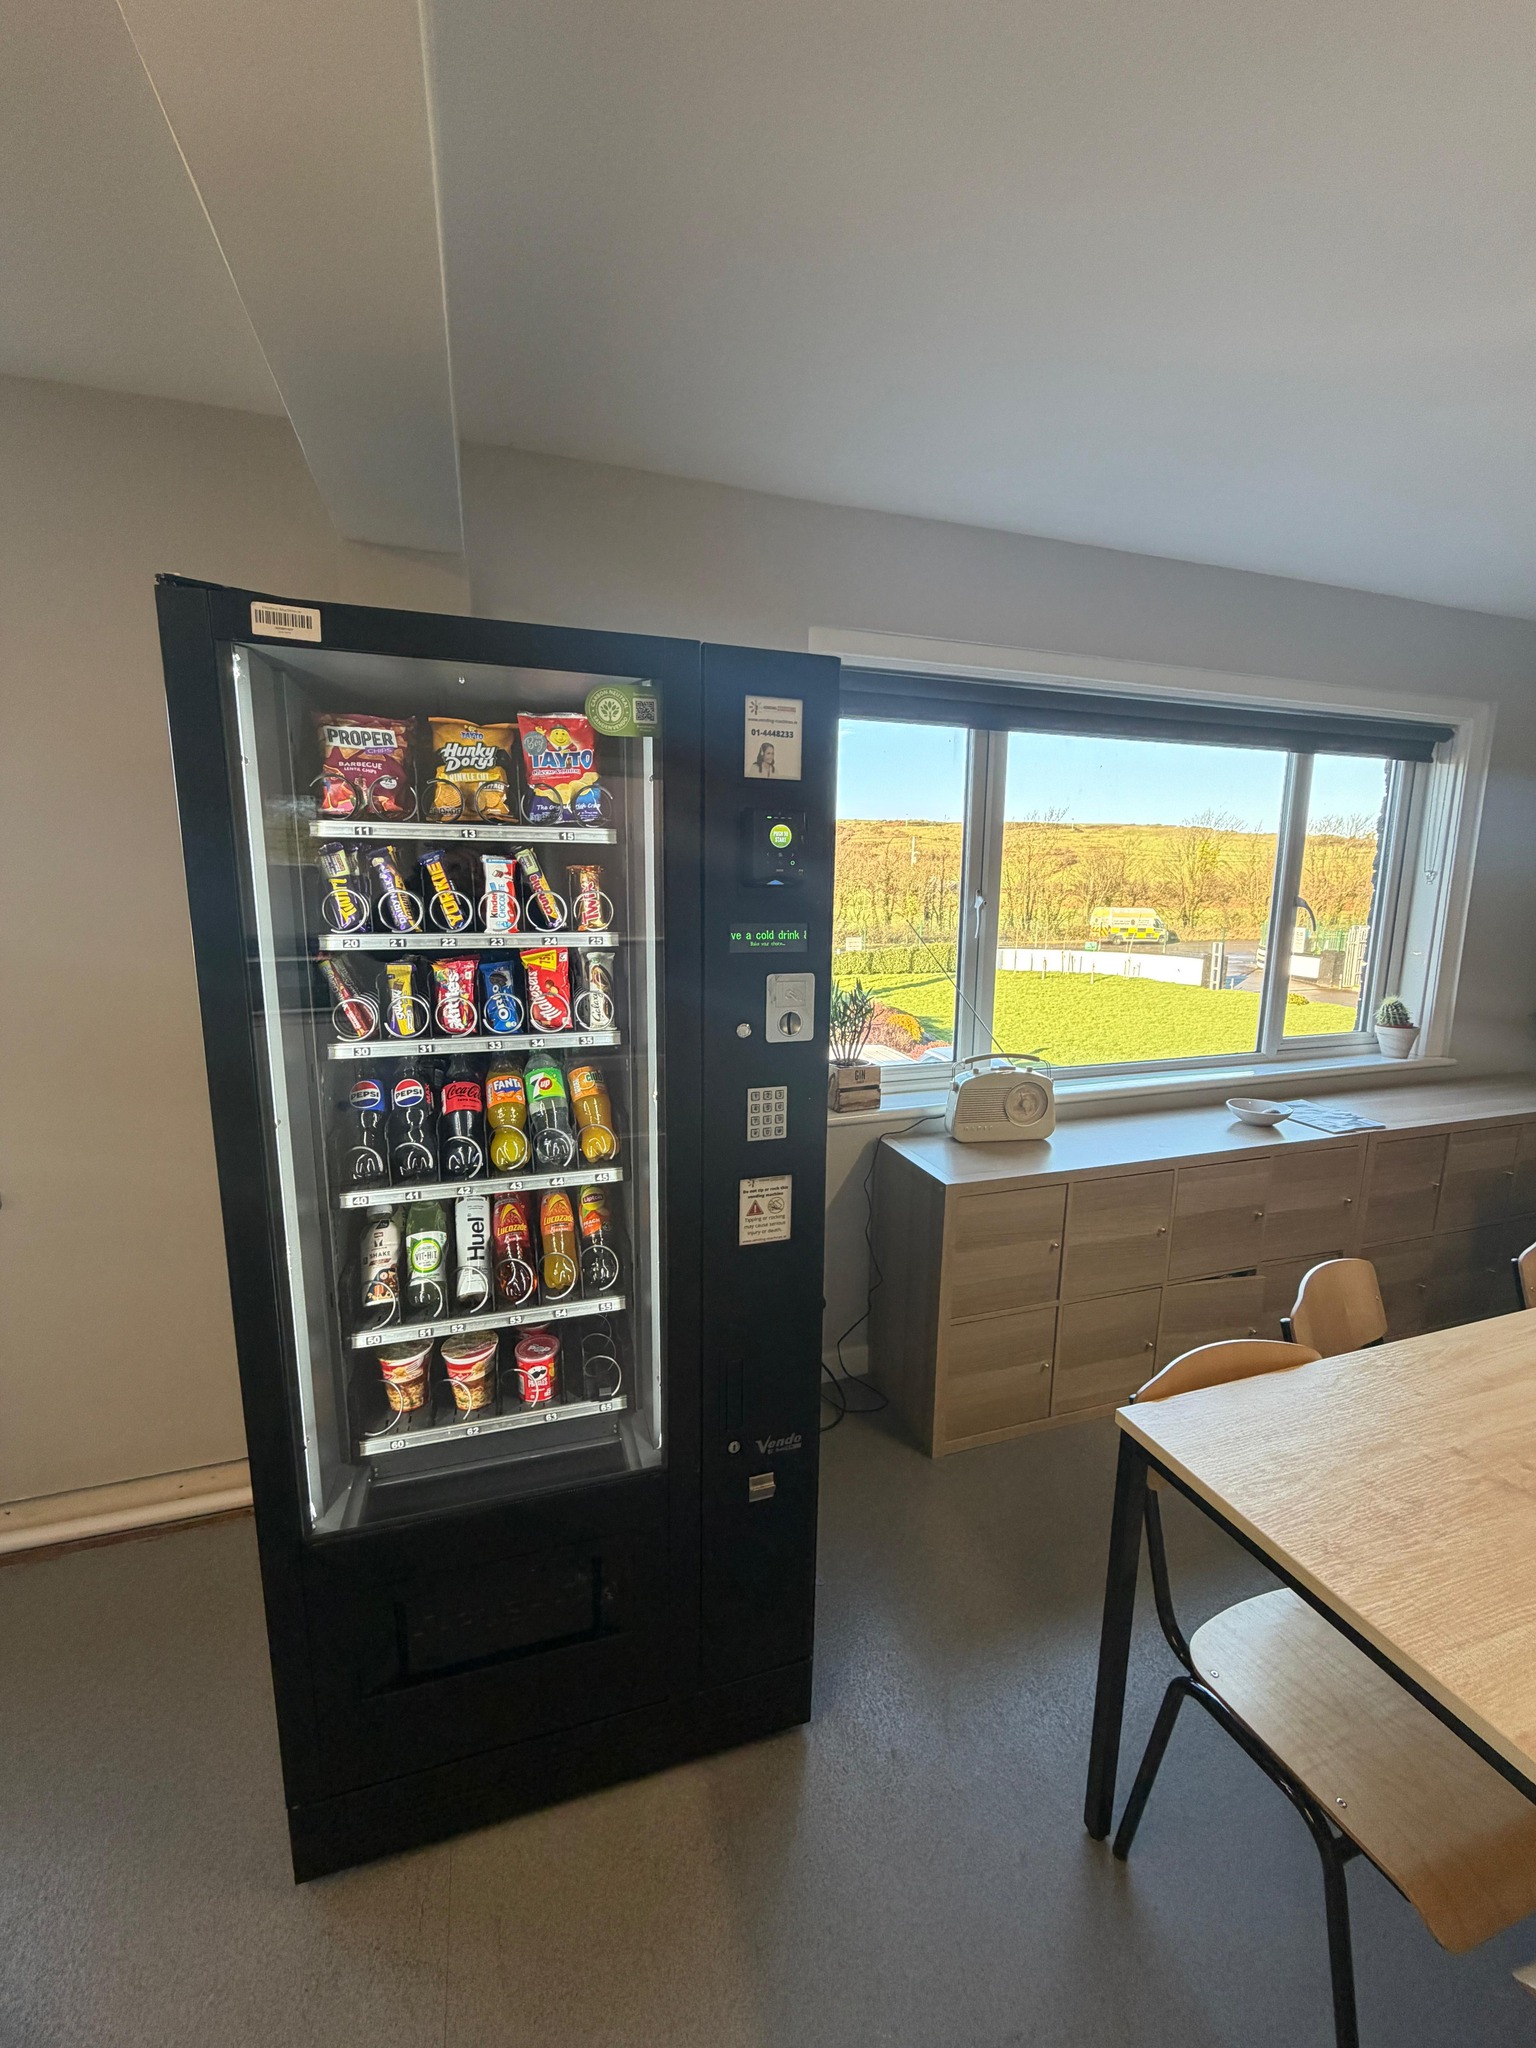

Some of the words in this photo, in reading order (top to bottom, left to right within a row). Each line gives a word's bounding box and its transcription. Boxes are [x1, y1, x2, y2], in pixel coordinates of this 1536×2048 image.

[591, 689, 608, 707] CARBON
[609, 689, 629, 708] NEUTRAL
[326, 728, 394, 747] PROPER
[751, 728, 794, 739] 01-4448233
[367, 747, 393, 755] CHIPS
[441, 742, 497, 760] Hunky
[528, 749, 593, 770] TAYTO
[338, 761, 383, 770] BARBECUE
[445, 756, 496, 773] Dorys
[356, 827, 371, 836] 11
[462, 830, 476, 838] 13
[427, 861, 464, 927] YORKIE
[730, 932, 742, 940] ve
[745, 932, 752, 940] a
[755, 930, 774, 940] cold
[778, 930, 800, 940] drink
[343, 939, 358, 947] 20
[390, 939, 404, 947] 21
[442, 938, 455, 946] 22
[491, 938, 504, 946] 23
[544, 937, 557, 945] 24
[591, 991, 604, 1022] Galaxy
[355, 1048, 369, 1056] 30
[351, 1091, 379, 1100] PEPSI
[395, 1088, 422, 1098] PEPSI
[596, 1173, 609, 1181] 45
[510, 1182, 522, 1190] 43
[406, 1191, 419, 1199] 41
[458, 1187, 471, 1195] 42
[353, 1197, 367, 1205] 40
[583, 1195, 602, 1203] Lipton
[497, 1223, 527, 1236] Lucozade
[467, 1217, 484, 1260] Huel
[369, 1250, 391, 1259] SHAKE
[555, 1309, 567, 1317] 54
[420, 1329, 431, 1337] 51
[367, 1336, 381, 1345] 50
[600, 1403, 612, 1411] 65
[545, 1413, 557, 1421] 63
[467, 1427, 479, 1435] 62
[755, 1432, 802, 1454] Vendo
